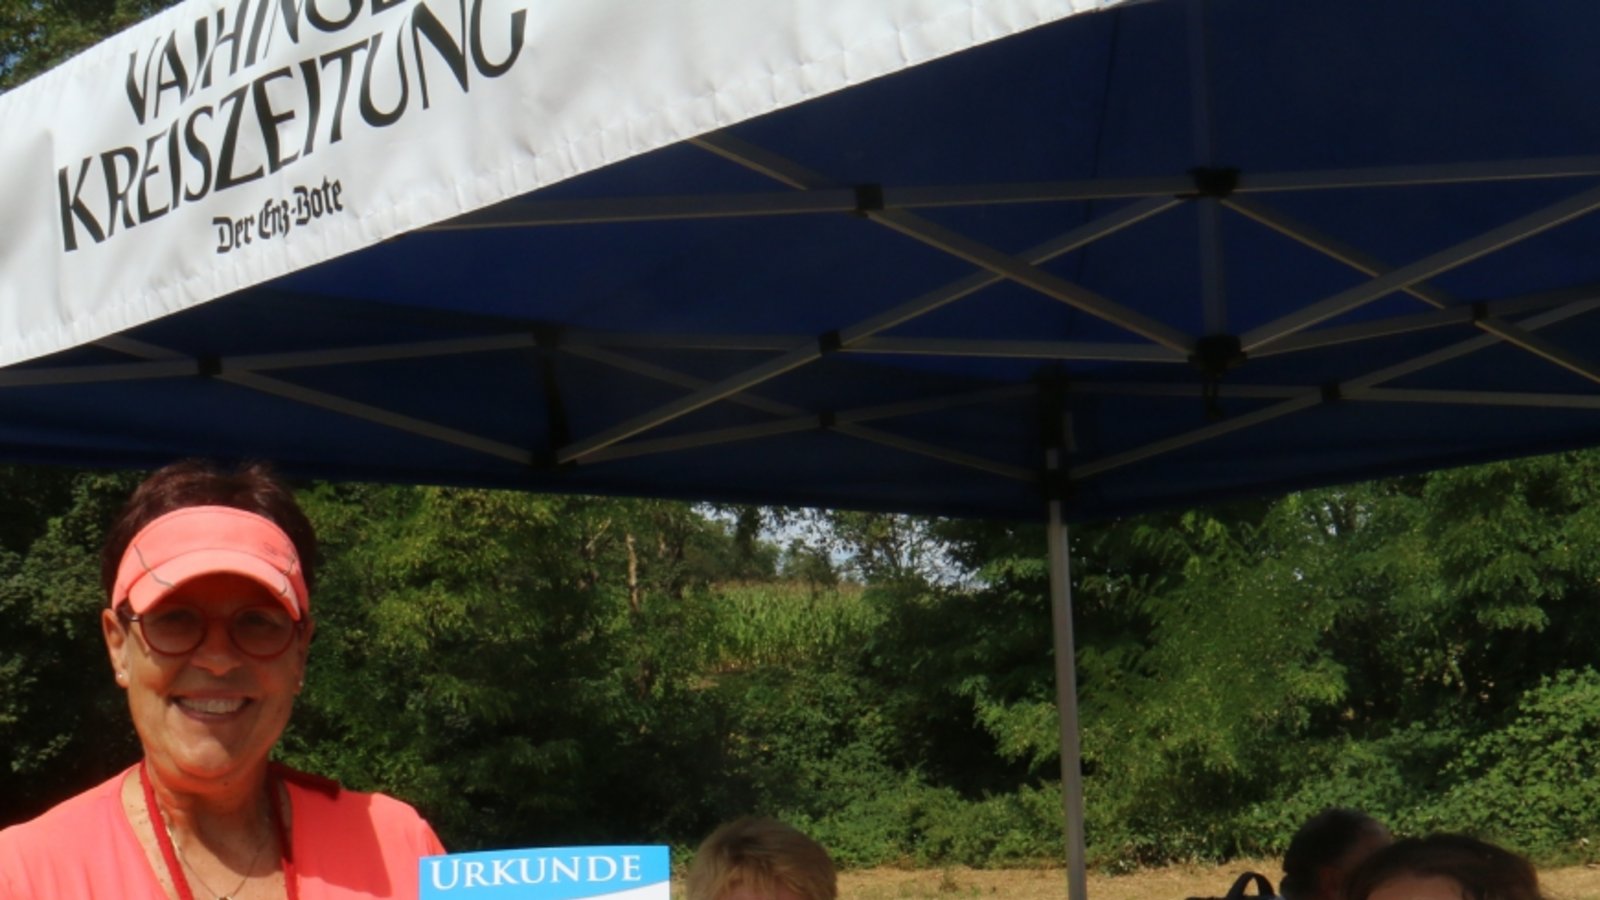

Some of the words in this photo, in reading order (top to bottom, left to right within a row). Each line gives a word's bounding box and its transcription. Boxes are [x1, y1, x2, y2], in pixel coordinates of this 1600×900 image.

[126, 0, 408, 125] VAIHIN
[58, 0, 527, 252] KREISZEITUNG
[212, 215, 255, 254] Der
[258, 175, 343, 239] Enz-Bote
[431, 854, 642, 890] URKUNDE
